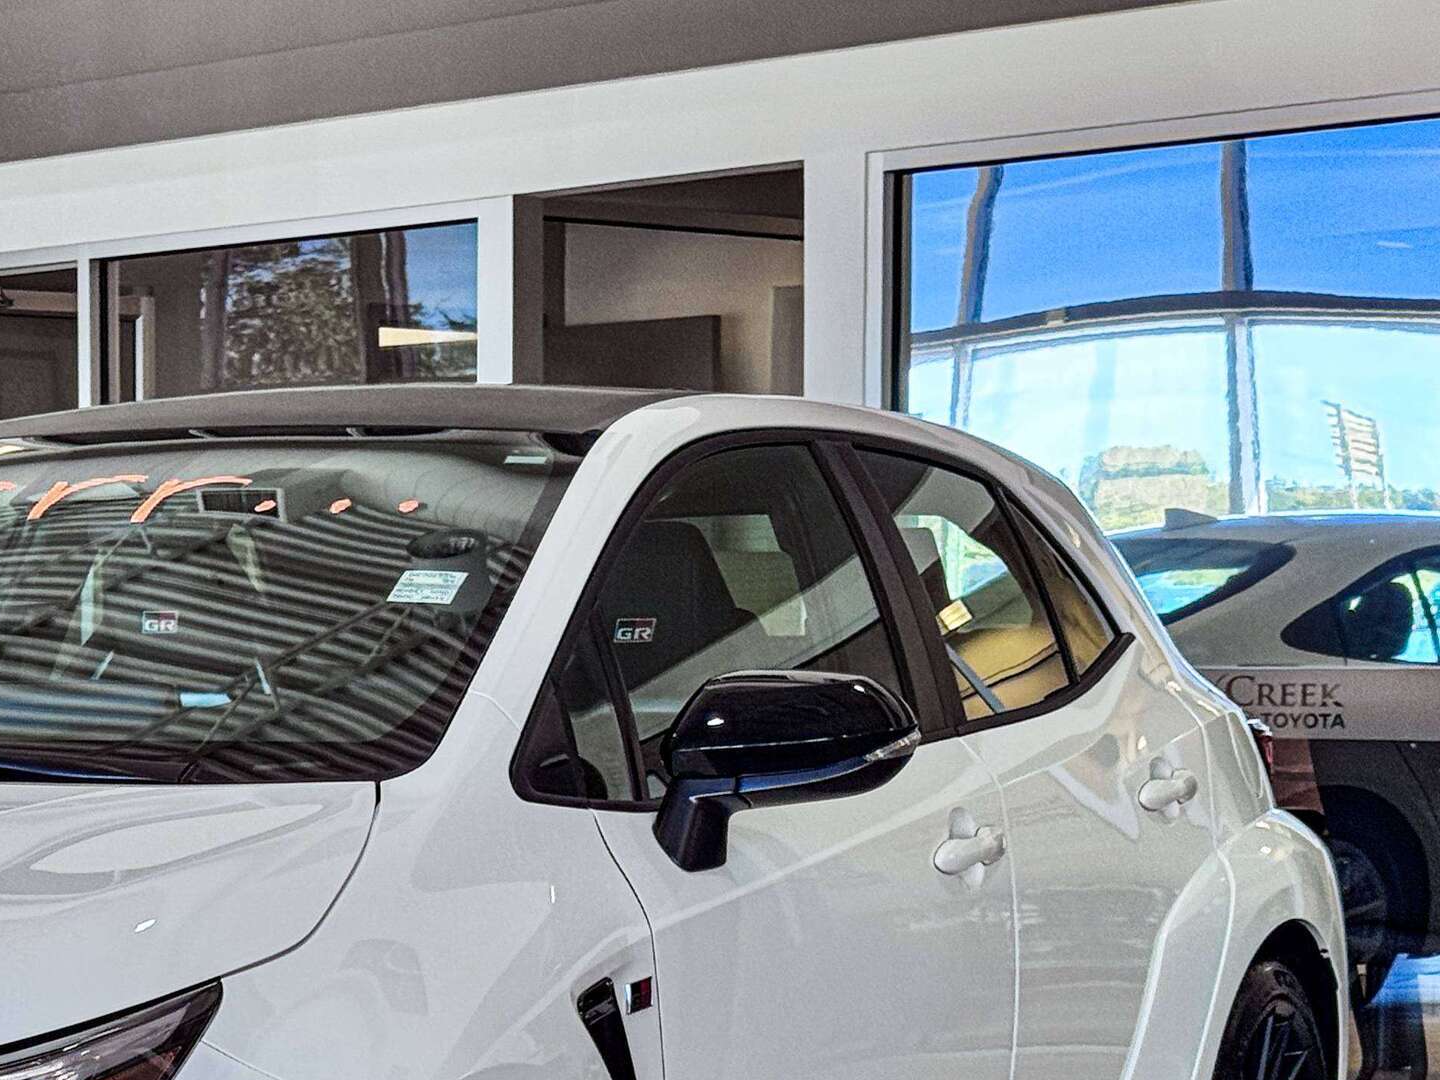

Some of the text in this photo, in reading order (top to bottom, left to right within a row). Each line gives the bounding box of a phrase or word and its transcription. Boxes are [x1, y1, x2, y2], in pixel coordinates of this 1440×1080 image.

[144, 619, 175, 632] GR
[617, 627, 651, 640] GR
[1226, 675, 1344, 708] CREEK
[1263, 712, 1346, 729] TOYOTA
